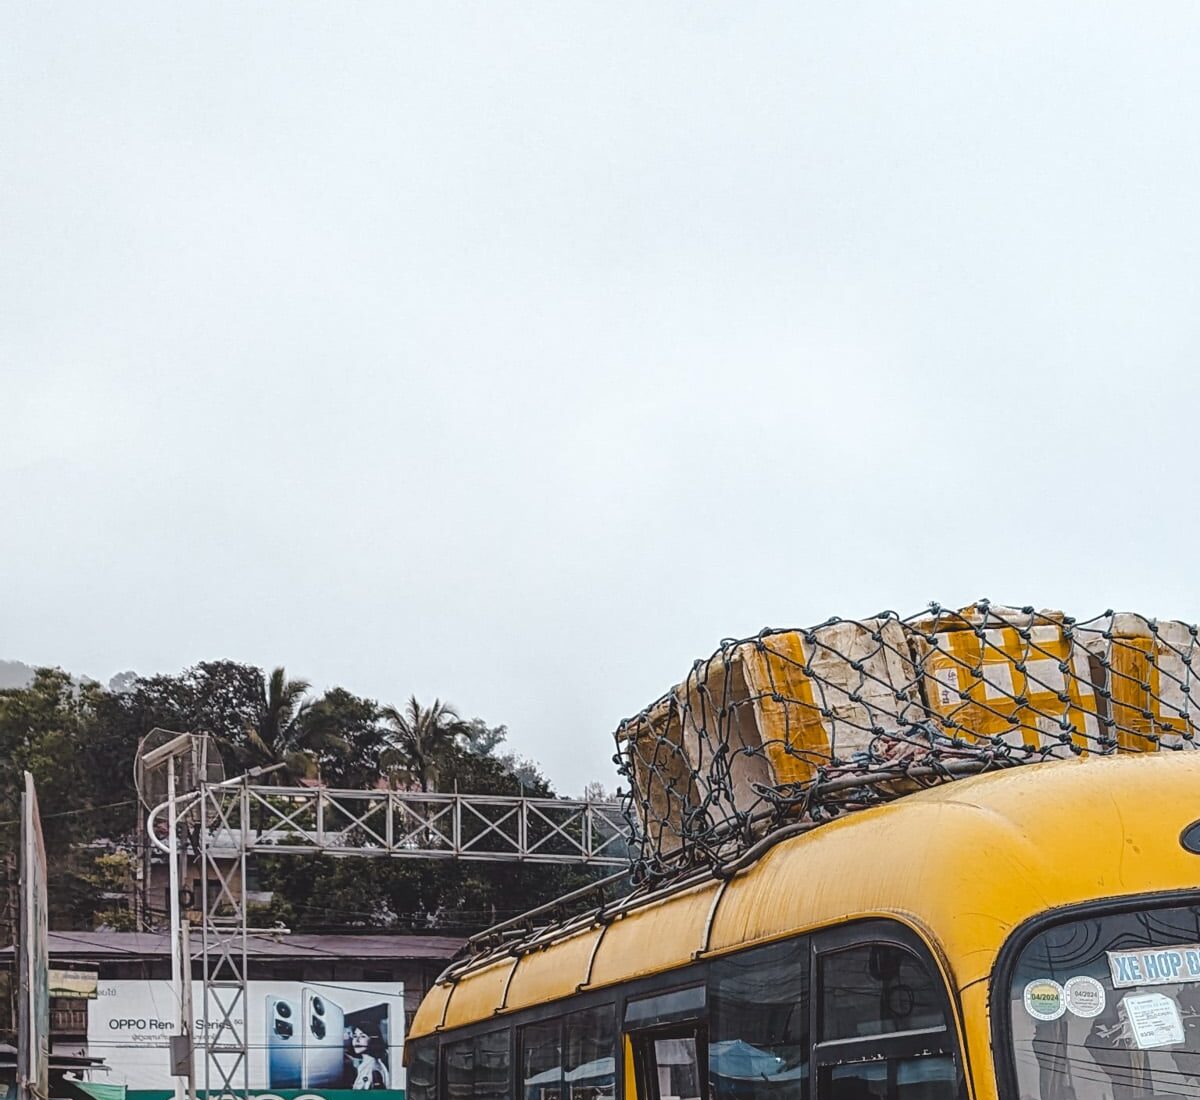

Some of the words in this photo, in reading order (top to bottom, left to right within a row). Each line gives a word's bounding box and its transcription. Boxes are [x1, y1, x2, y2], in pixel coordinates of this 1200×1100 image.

[1115, 956, 1142, 981] XE
[1031, 993, 1059, 1001] 04/2024
[109, 1019, 146, 1030] OPPO
[149, 1019, 175, 1030] Ren
[195, 1018, 233, 1030] Series
